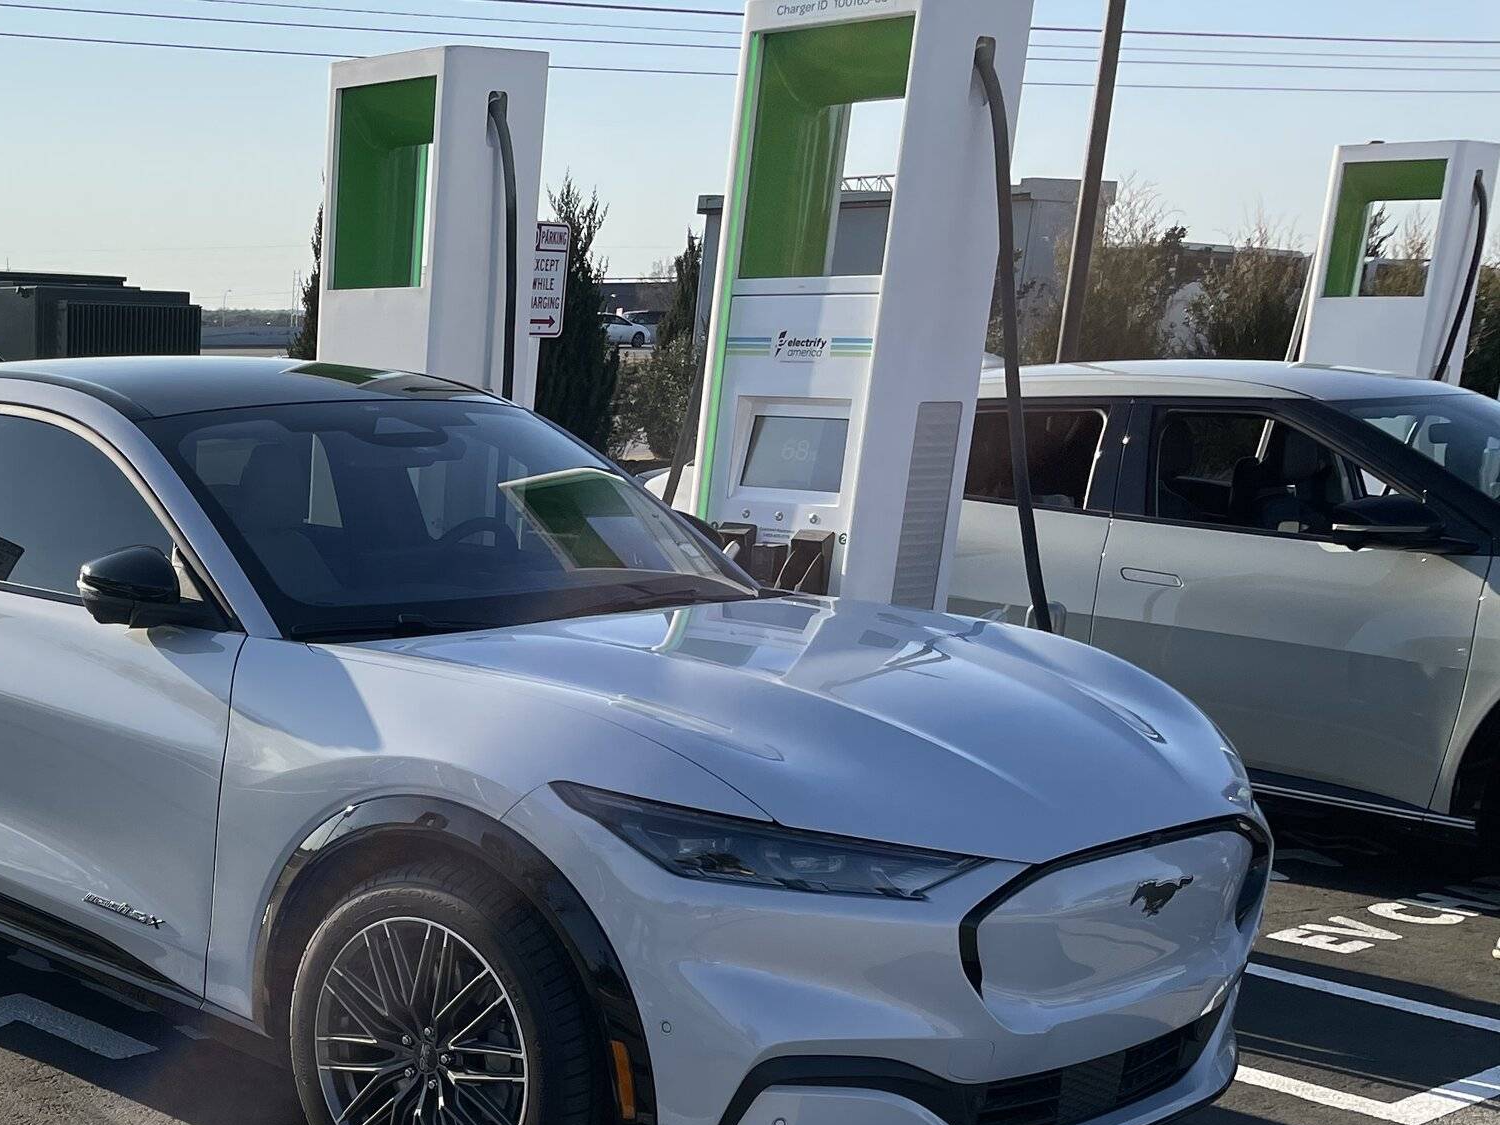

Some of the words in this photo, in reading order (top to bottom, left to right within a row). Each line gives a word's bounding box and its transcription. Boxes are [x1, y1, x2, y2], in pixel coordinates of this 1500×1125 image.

[776, 4, 815, 16] Charger
[817, 0, 828, 11] ID
[541, 230, 567, 245] PARKING
[534, 258, 560, 272] XCEPT
[531, 296, 560, 310] ARGING
[787, 337, 827, 349] electrify
[787, 349, 822, 357] america
[1265, 915, 1403, 954] EV
